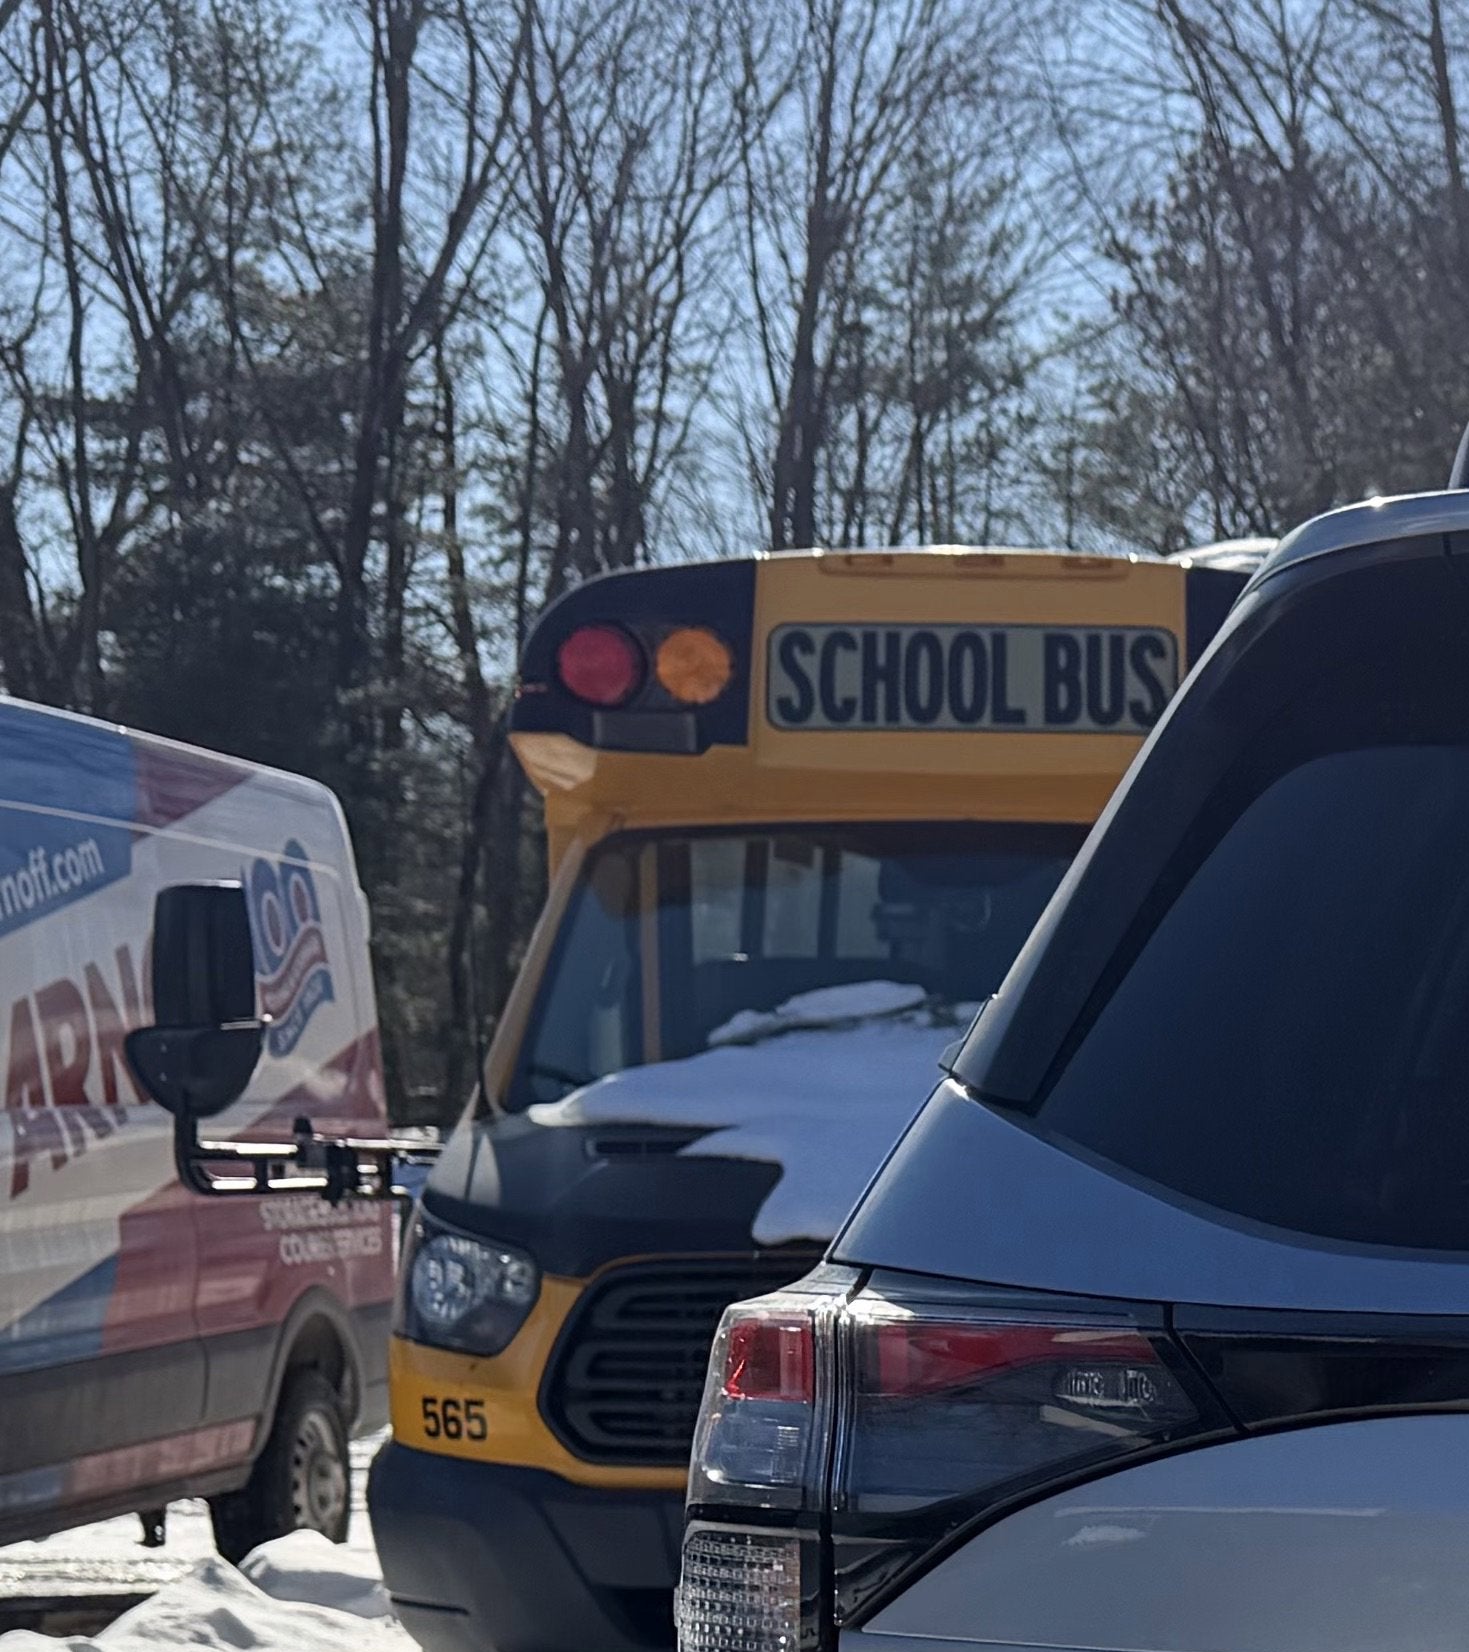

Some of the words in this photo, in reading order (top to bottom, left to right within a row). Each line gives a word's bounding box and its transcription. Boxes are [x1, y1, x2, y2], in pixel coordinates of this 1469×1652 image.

[775, 630, 1026, 725] SCHOOL
[1044, 633, 1167, 727] BUS
[0, 838, 104, 919] noff.com
[422, 1397, 488, 1442] 565
